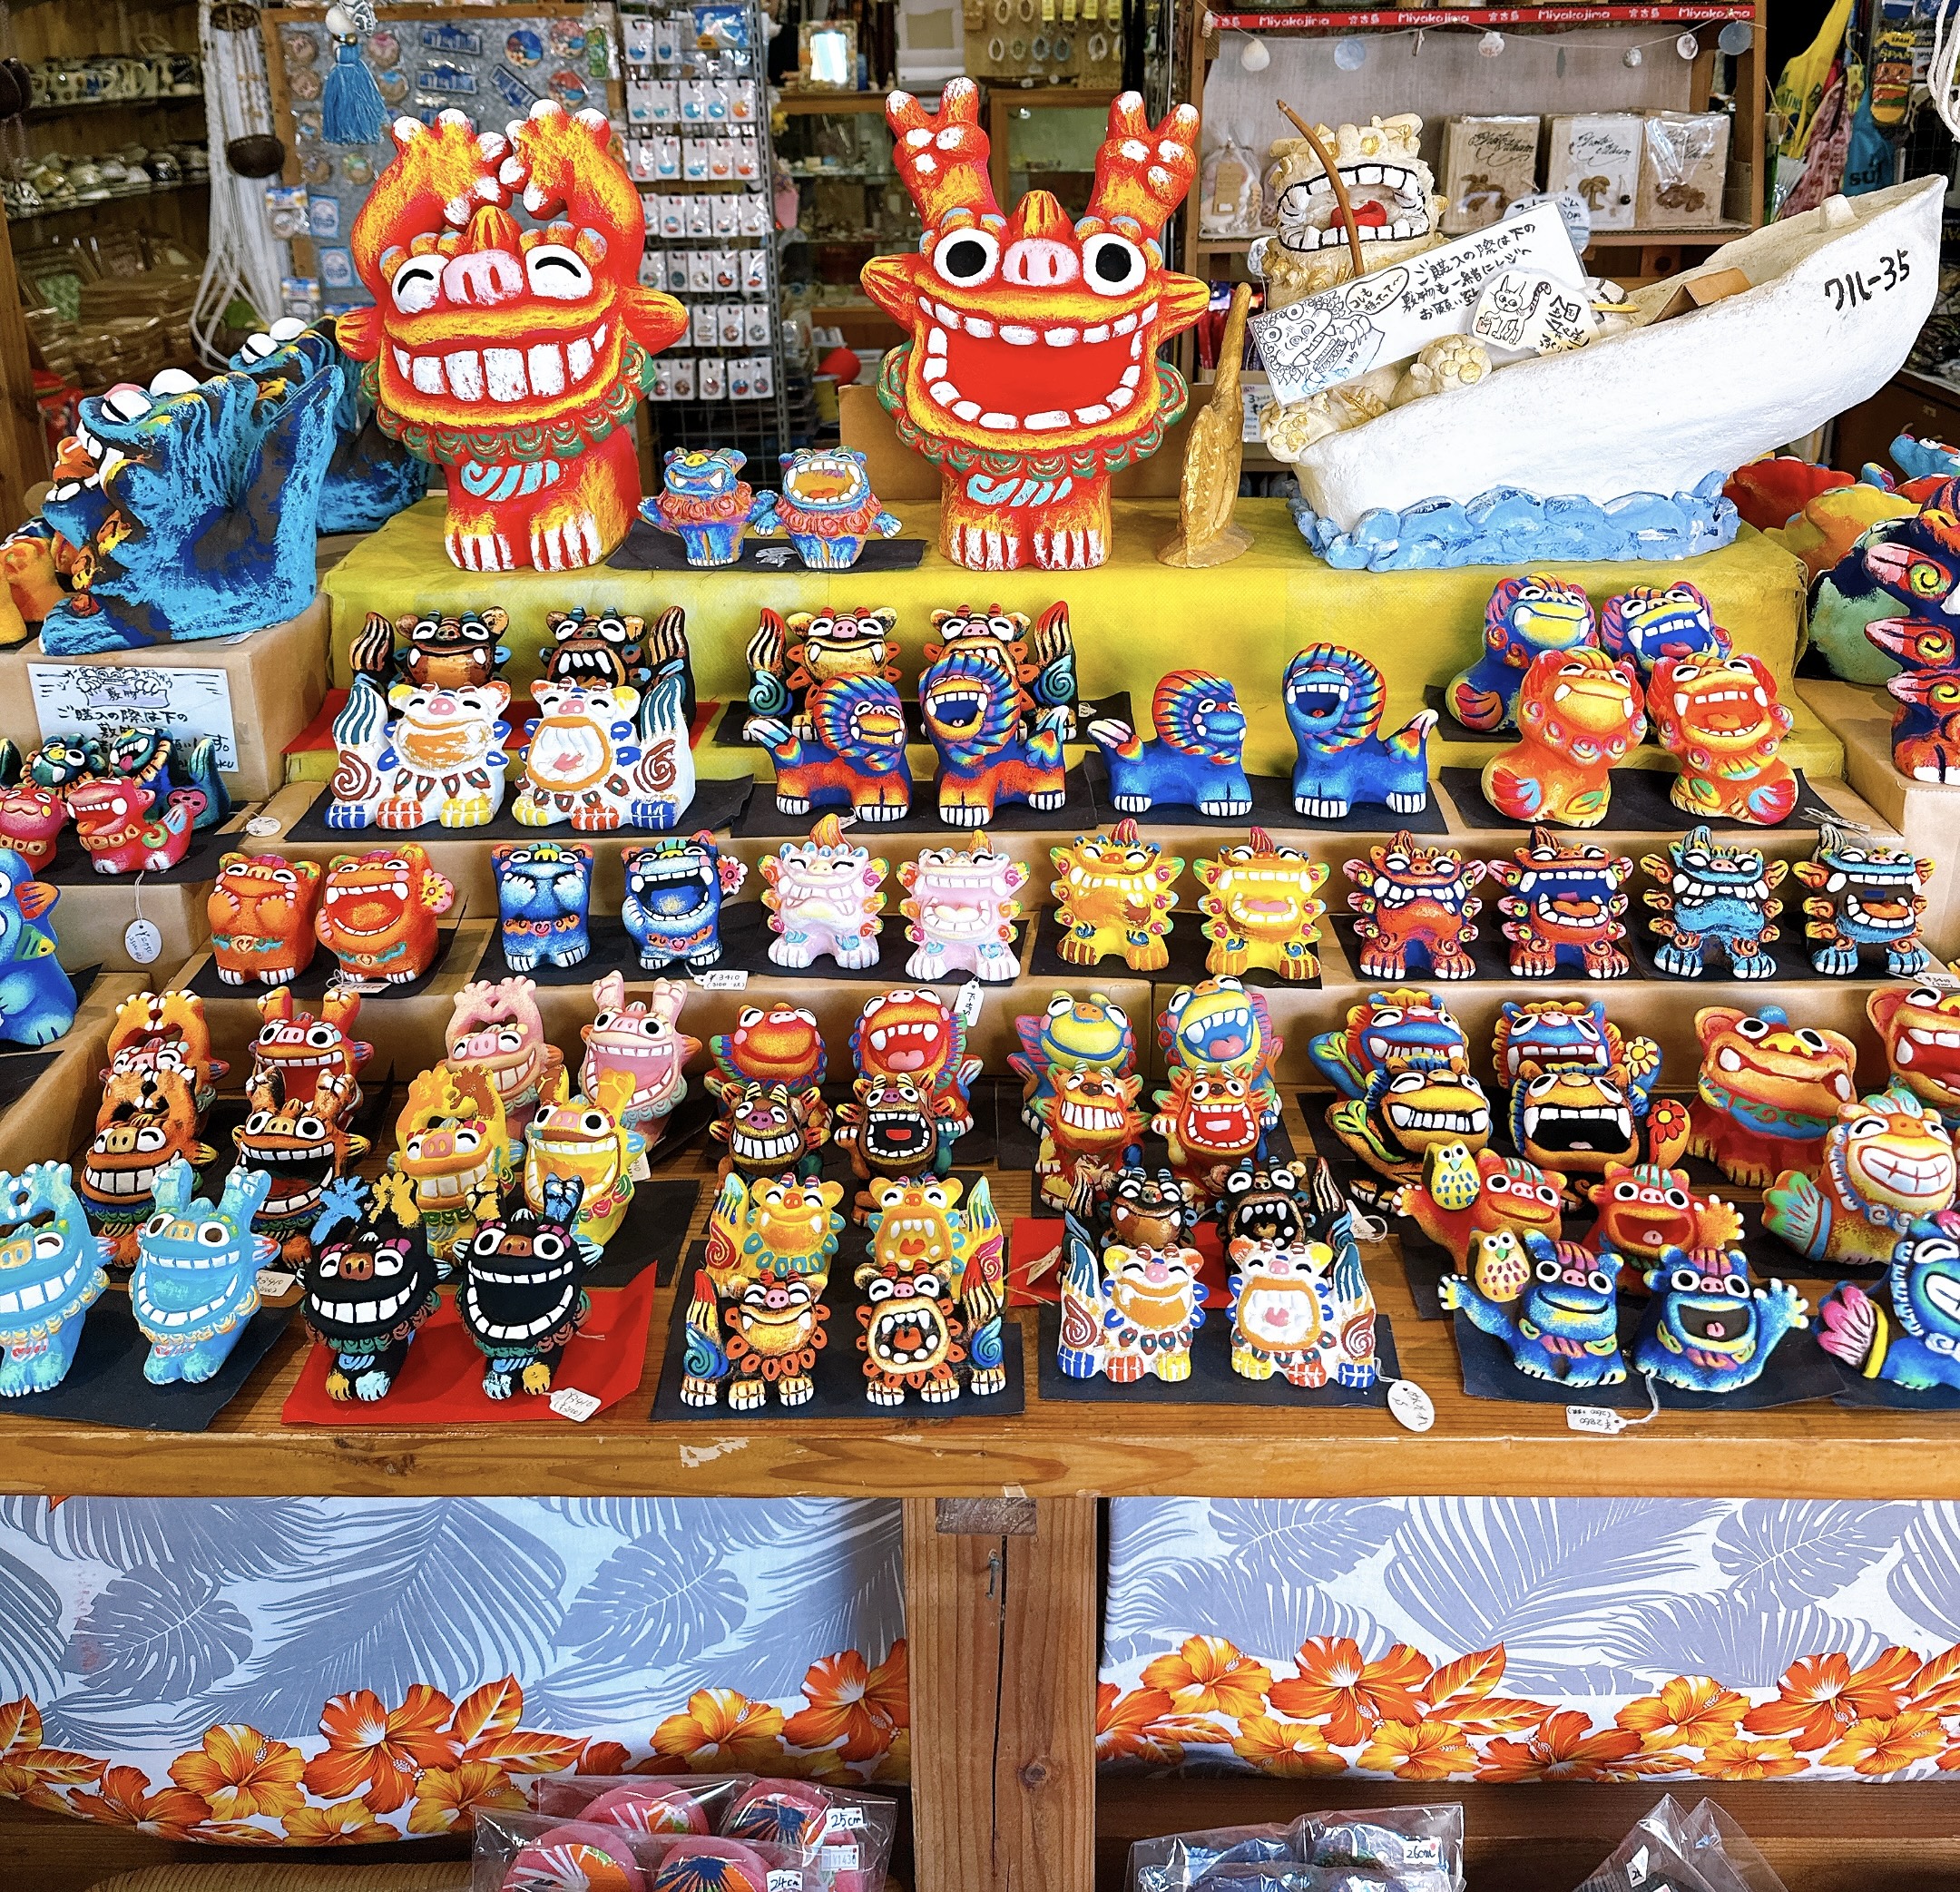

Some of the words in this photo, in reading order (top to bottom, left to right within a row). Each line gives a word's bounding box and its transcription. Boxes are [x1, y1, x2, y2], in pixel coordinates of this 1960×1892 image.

[1538, 8, 1610, 20] Miyakojima
[57, 705, 189, 725] ご購入の際は下の
[830, 1812, 863, 1828] 25cm
